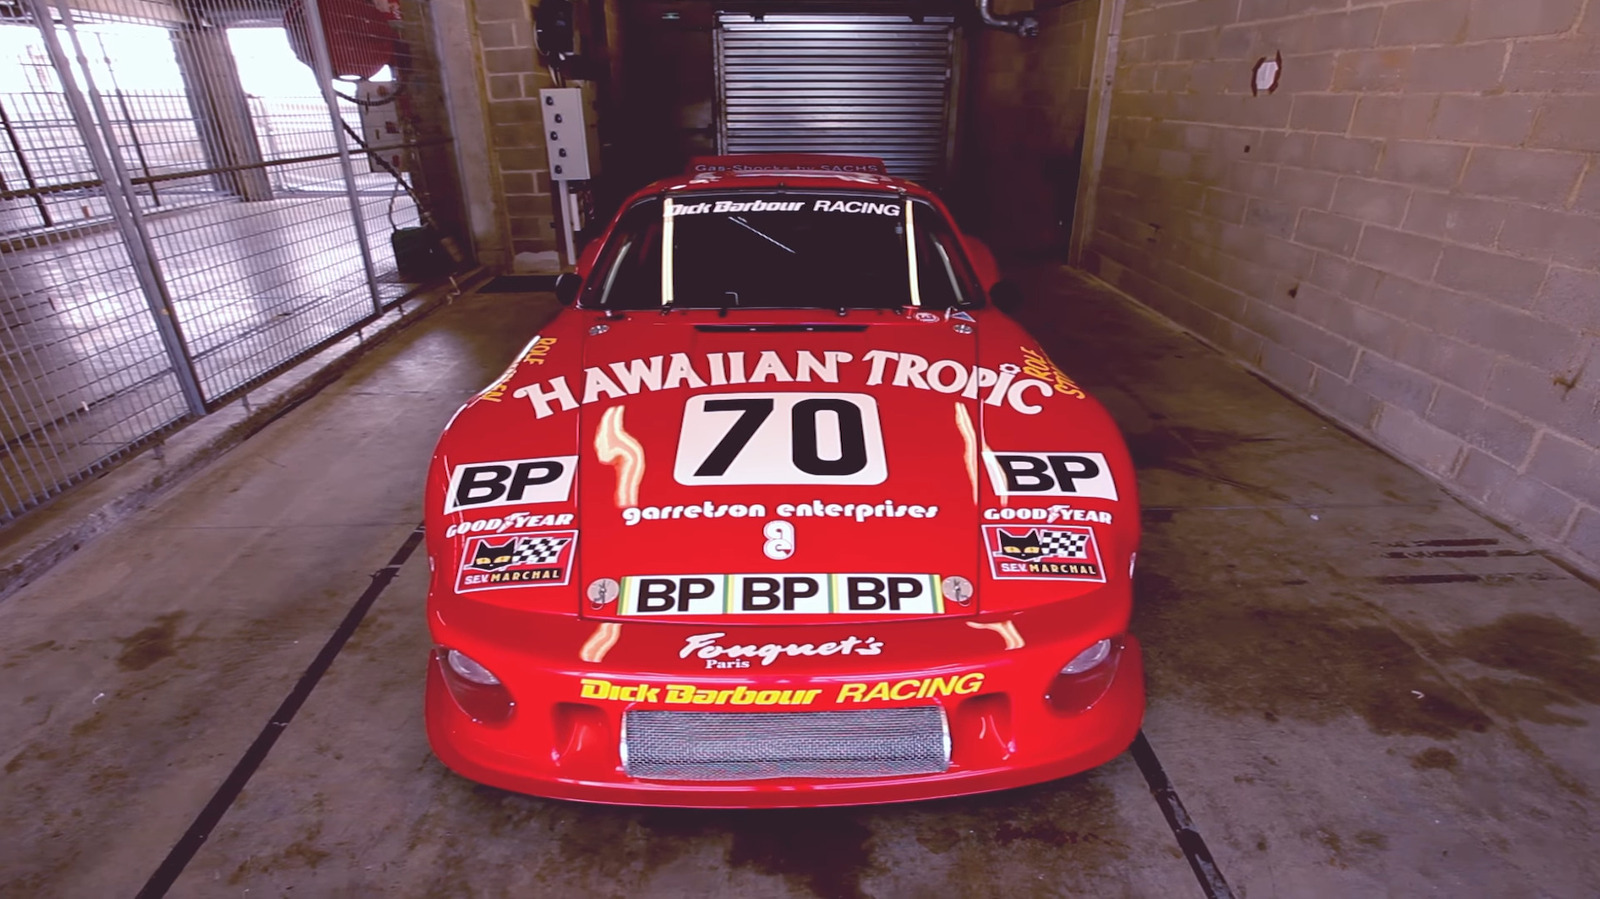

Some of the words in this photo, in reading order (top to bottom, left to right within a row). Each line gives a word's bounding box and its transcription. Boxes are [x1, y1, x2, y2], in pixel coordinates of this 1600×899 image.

[820, 164, 878, 173] SACHS
[664, 201, 711, 216] Dick
[714, 200, 805, 214] Barbour
[813, 199, 901, 216] RACING
[513, 350, 852, 419] HAWAIIAN
[862, 350, 1053, 414] TROPIC
[694, 398, 867, 476] 70
[452, 460, 564, 508] BP
[995, 455, 1099, 492] BP
[623, 501, 766, 525] garretson
[776, 501, 938, 522] enterprises
[490, 570, 560, 583] MARCHAL
[1029, 564, 1096, 575] MARCHAL
[638, 578, 714, 612] BP
[742, 577, 819, 611] BP
[848, 577, 923, 611] BP
[705, 659, 750, 669] Paris
[580, 679, 659, 703] Dick
[666, 684, 820, 704] Barbour
[836, 673, 984, 703] RACING
